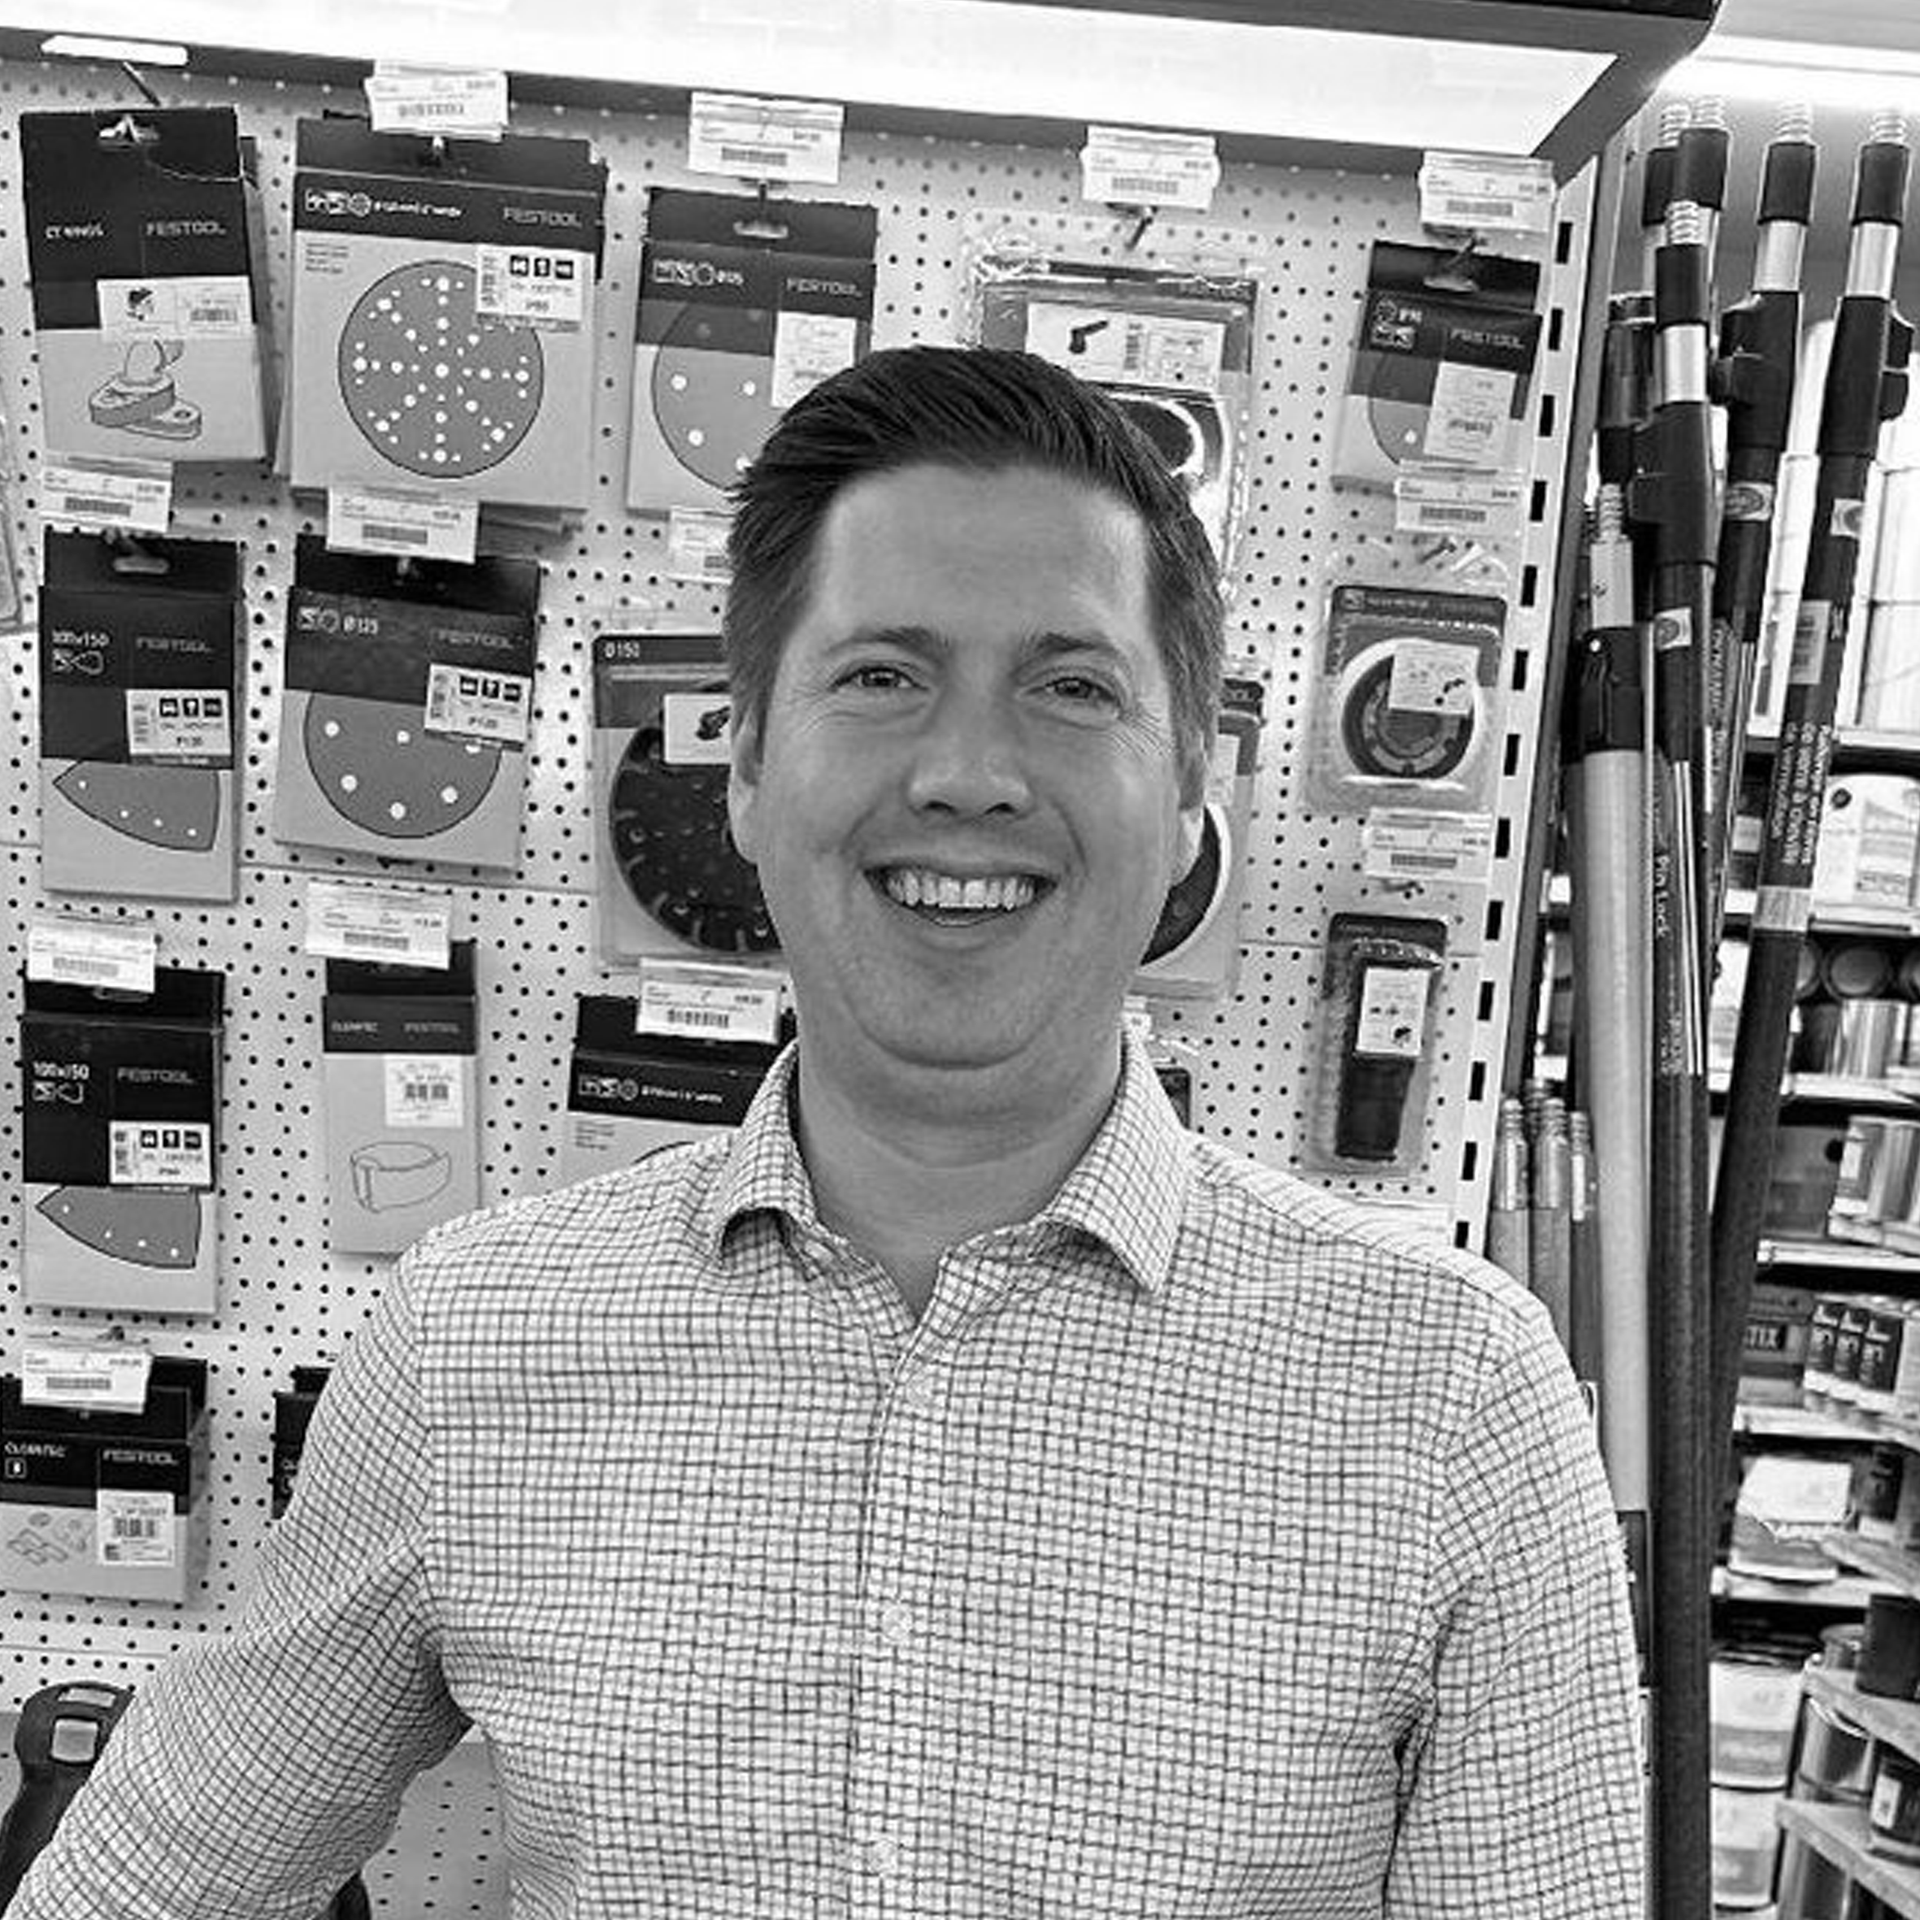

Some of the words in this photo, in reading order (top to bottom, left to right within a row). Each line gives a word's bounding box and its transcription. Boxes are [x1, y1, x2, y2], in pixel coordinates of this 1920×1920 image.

[504, 206, 583, 228] FESTOOL
[146, 220, 227, 237] FESTOOL
[1656, 890, 1671, 938] Lock
[116, 1066, 195, 1085] FESTOOL
[103, 1450, 179, 1466] FESTOOL
